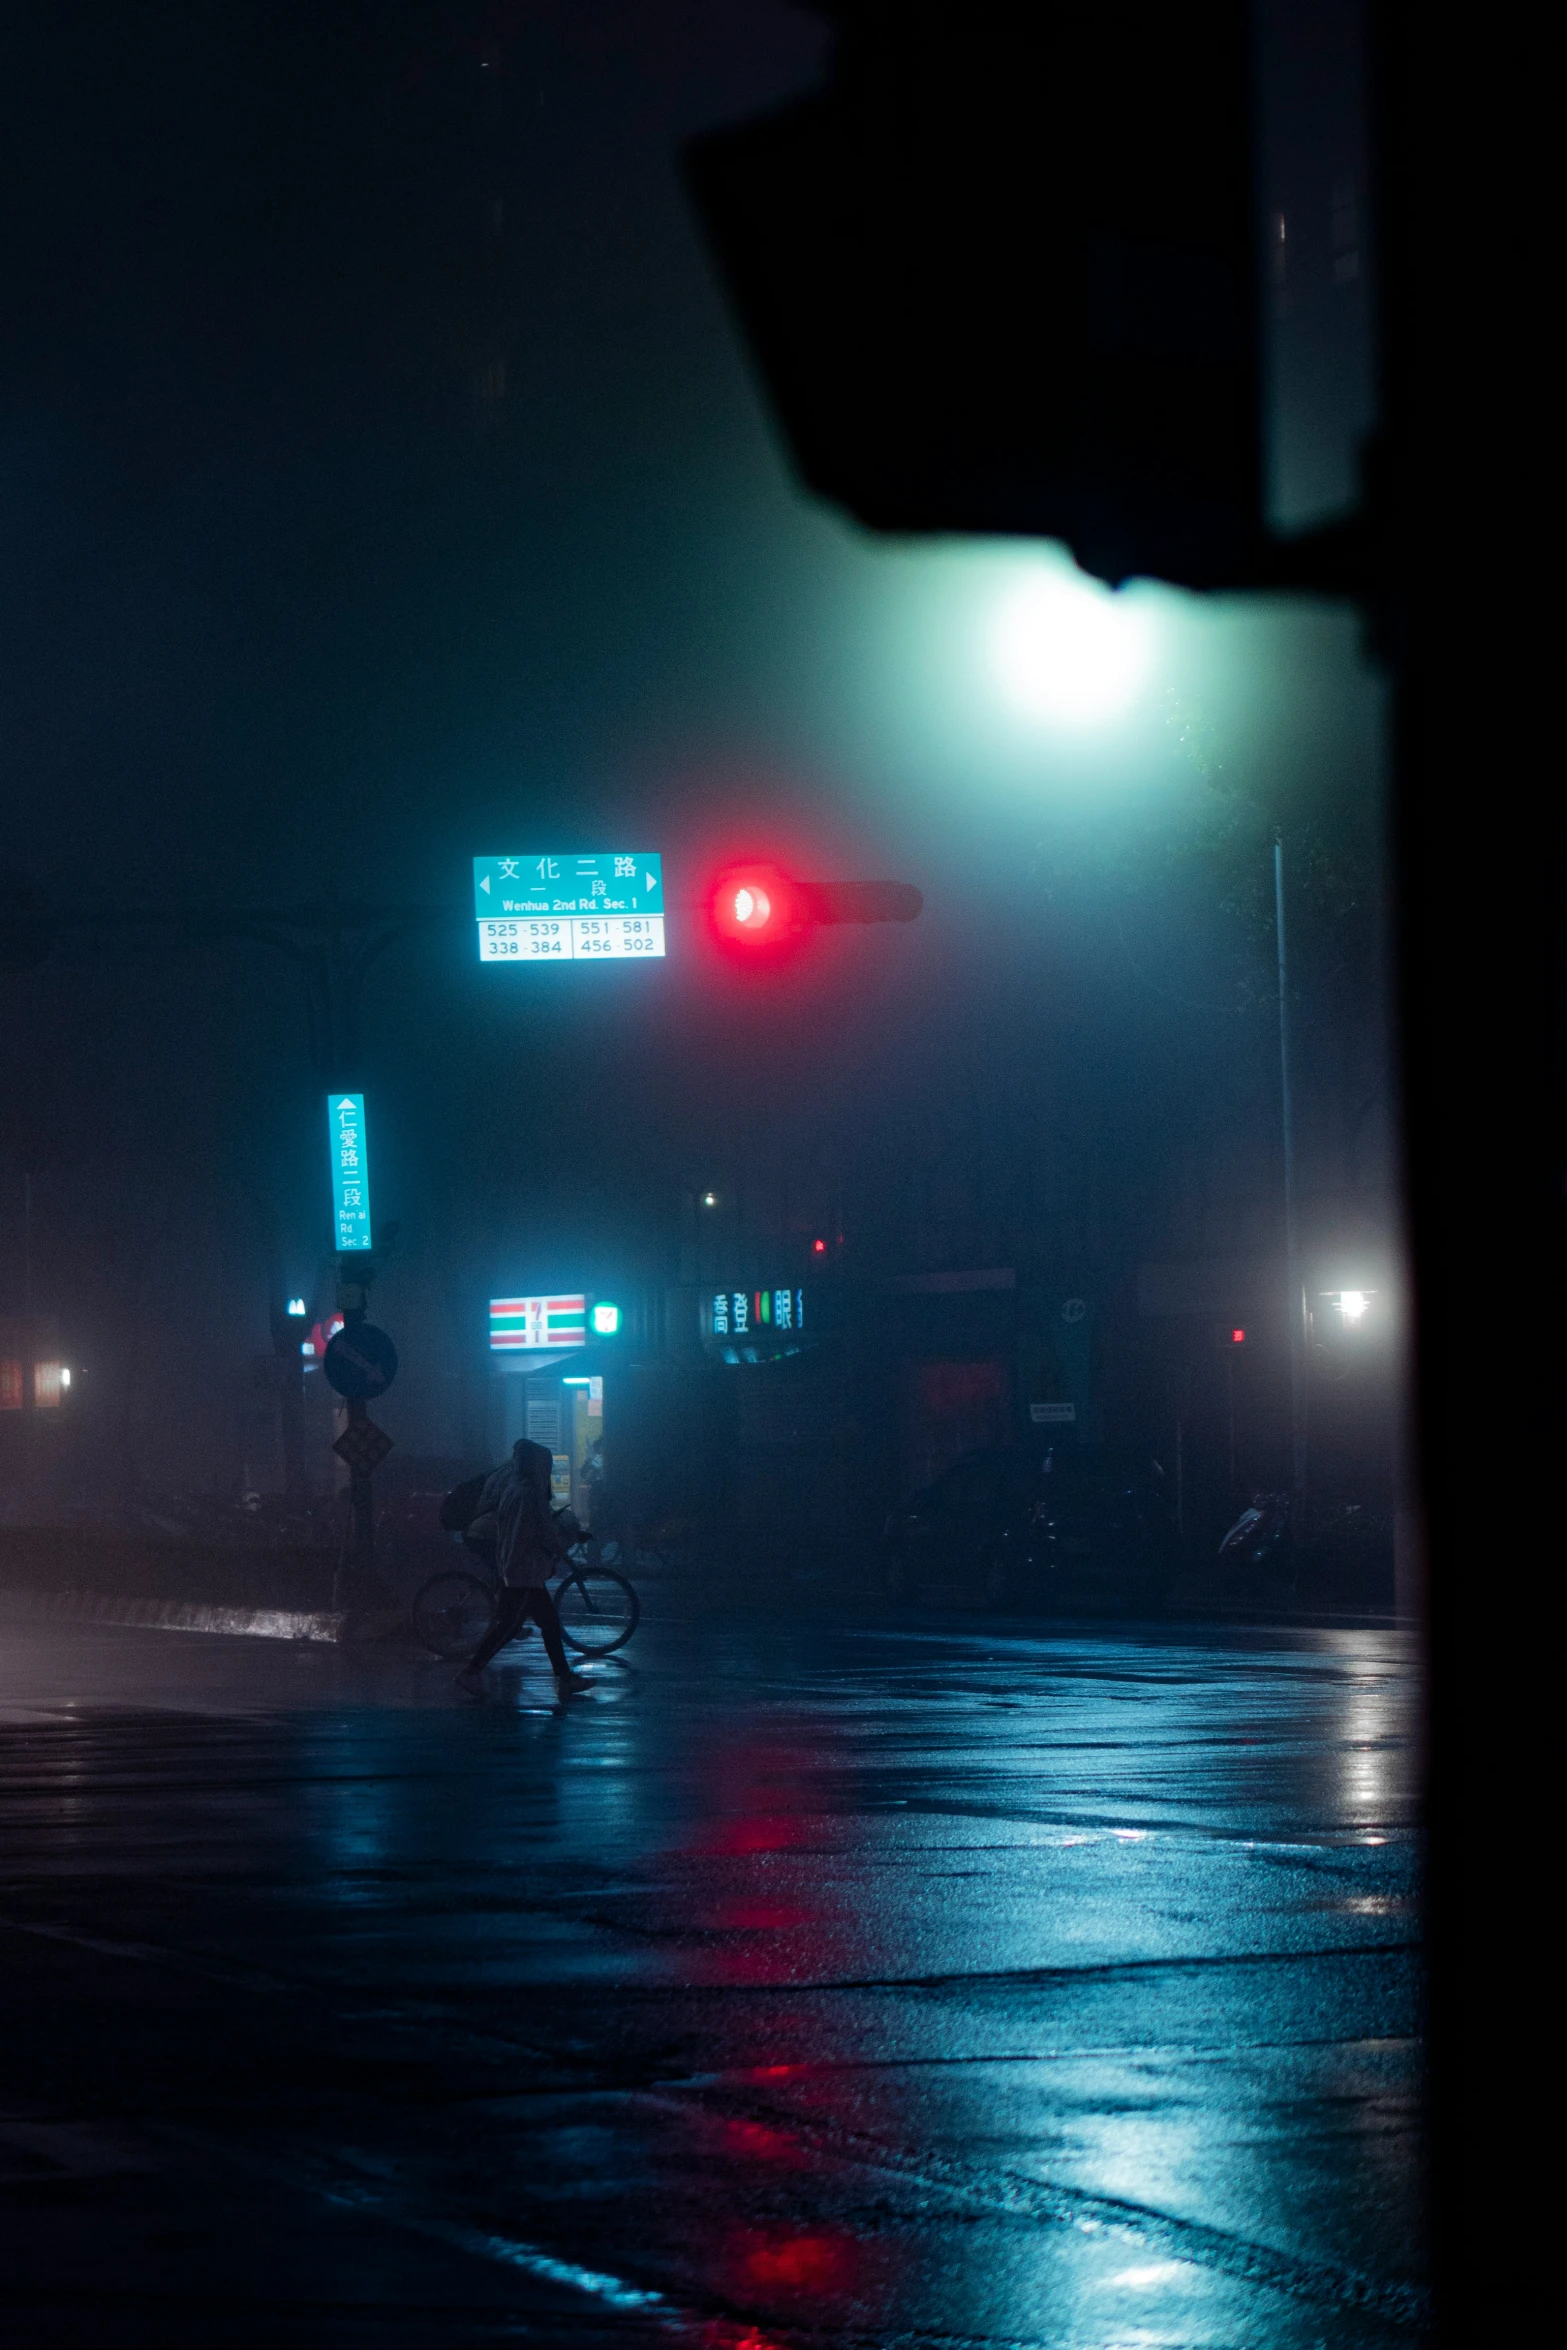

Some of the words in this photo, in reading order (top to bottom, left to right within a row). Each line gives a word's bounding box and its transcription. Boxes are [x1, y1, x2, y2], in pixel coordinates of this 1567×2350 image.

[498, 857, 637, 879] 文化二路
[530, 880, 607, 896] 一段
[502, 899, 550, 912] Wenhua
[552, 898, 577, 911] 2nd
[579, 898, 600, 910] Rd.
[603, 897, 629, 910] Sec.
[631, 896, 638, 909] 1
[338, 1110, 362, 1207] 仁愛路二段
[362, 1235, 369, 1246] 2
